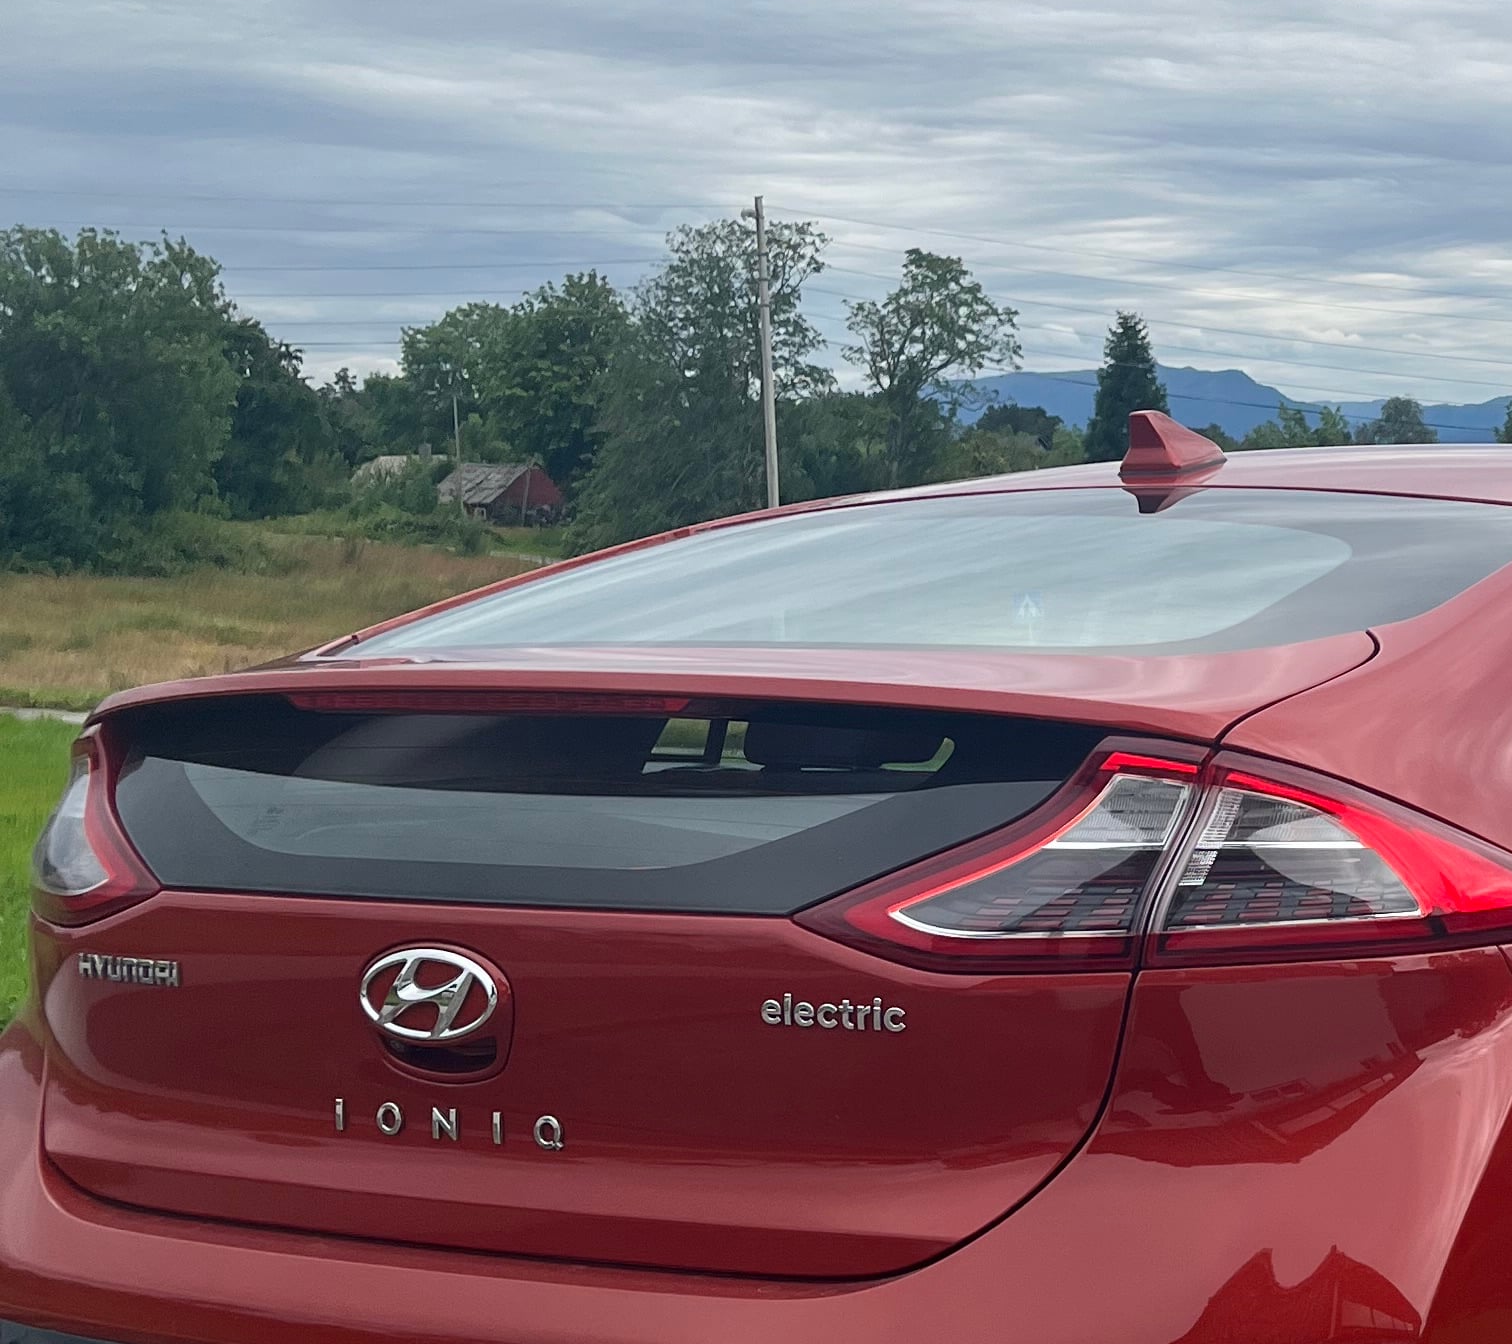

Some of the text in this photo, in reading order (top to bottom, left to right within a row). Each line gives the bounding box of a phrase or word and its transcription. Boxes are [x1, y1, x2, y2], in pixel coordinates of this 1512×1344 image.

[78, 952, 179, 987] HYUNDAI
[760, 992, 906, 1032] electric
[335, 1098, 564, 1151] IONIQ
